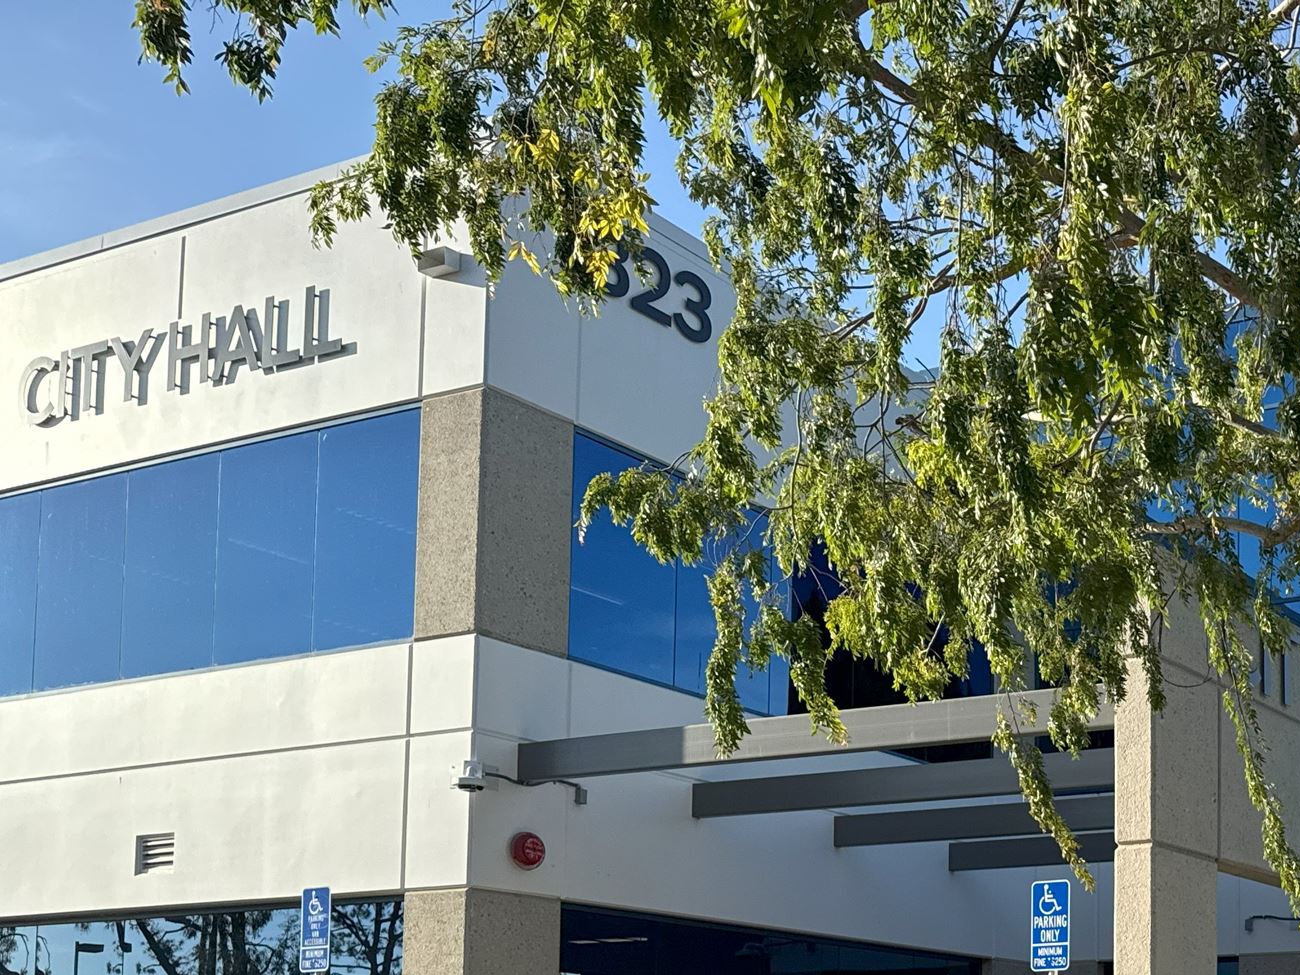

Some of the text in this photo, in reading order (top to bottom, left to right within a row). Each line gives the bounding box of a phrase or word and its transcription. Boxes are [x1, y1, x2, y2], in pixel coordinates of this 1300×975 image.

[19, 285, 342, 427] CITY HALL
[1033, 914, 1067, 929] PARKING
[1040, 929, 1060, 943] ONLY
[1037, 946, 1063, 957] MINIMUM
[1033, 957, 1046, 967] FINE
